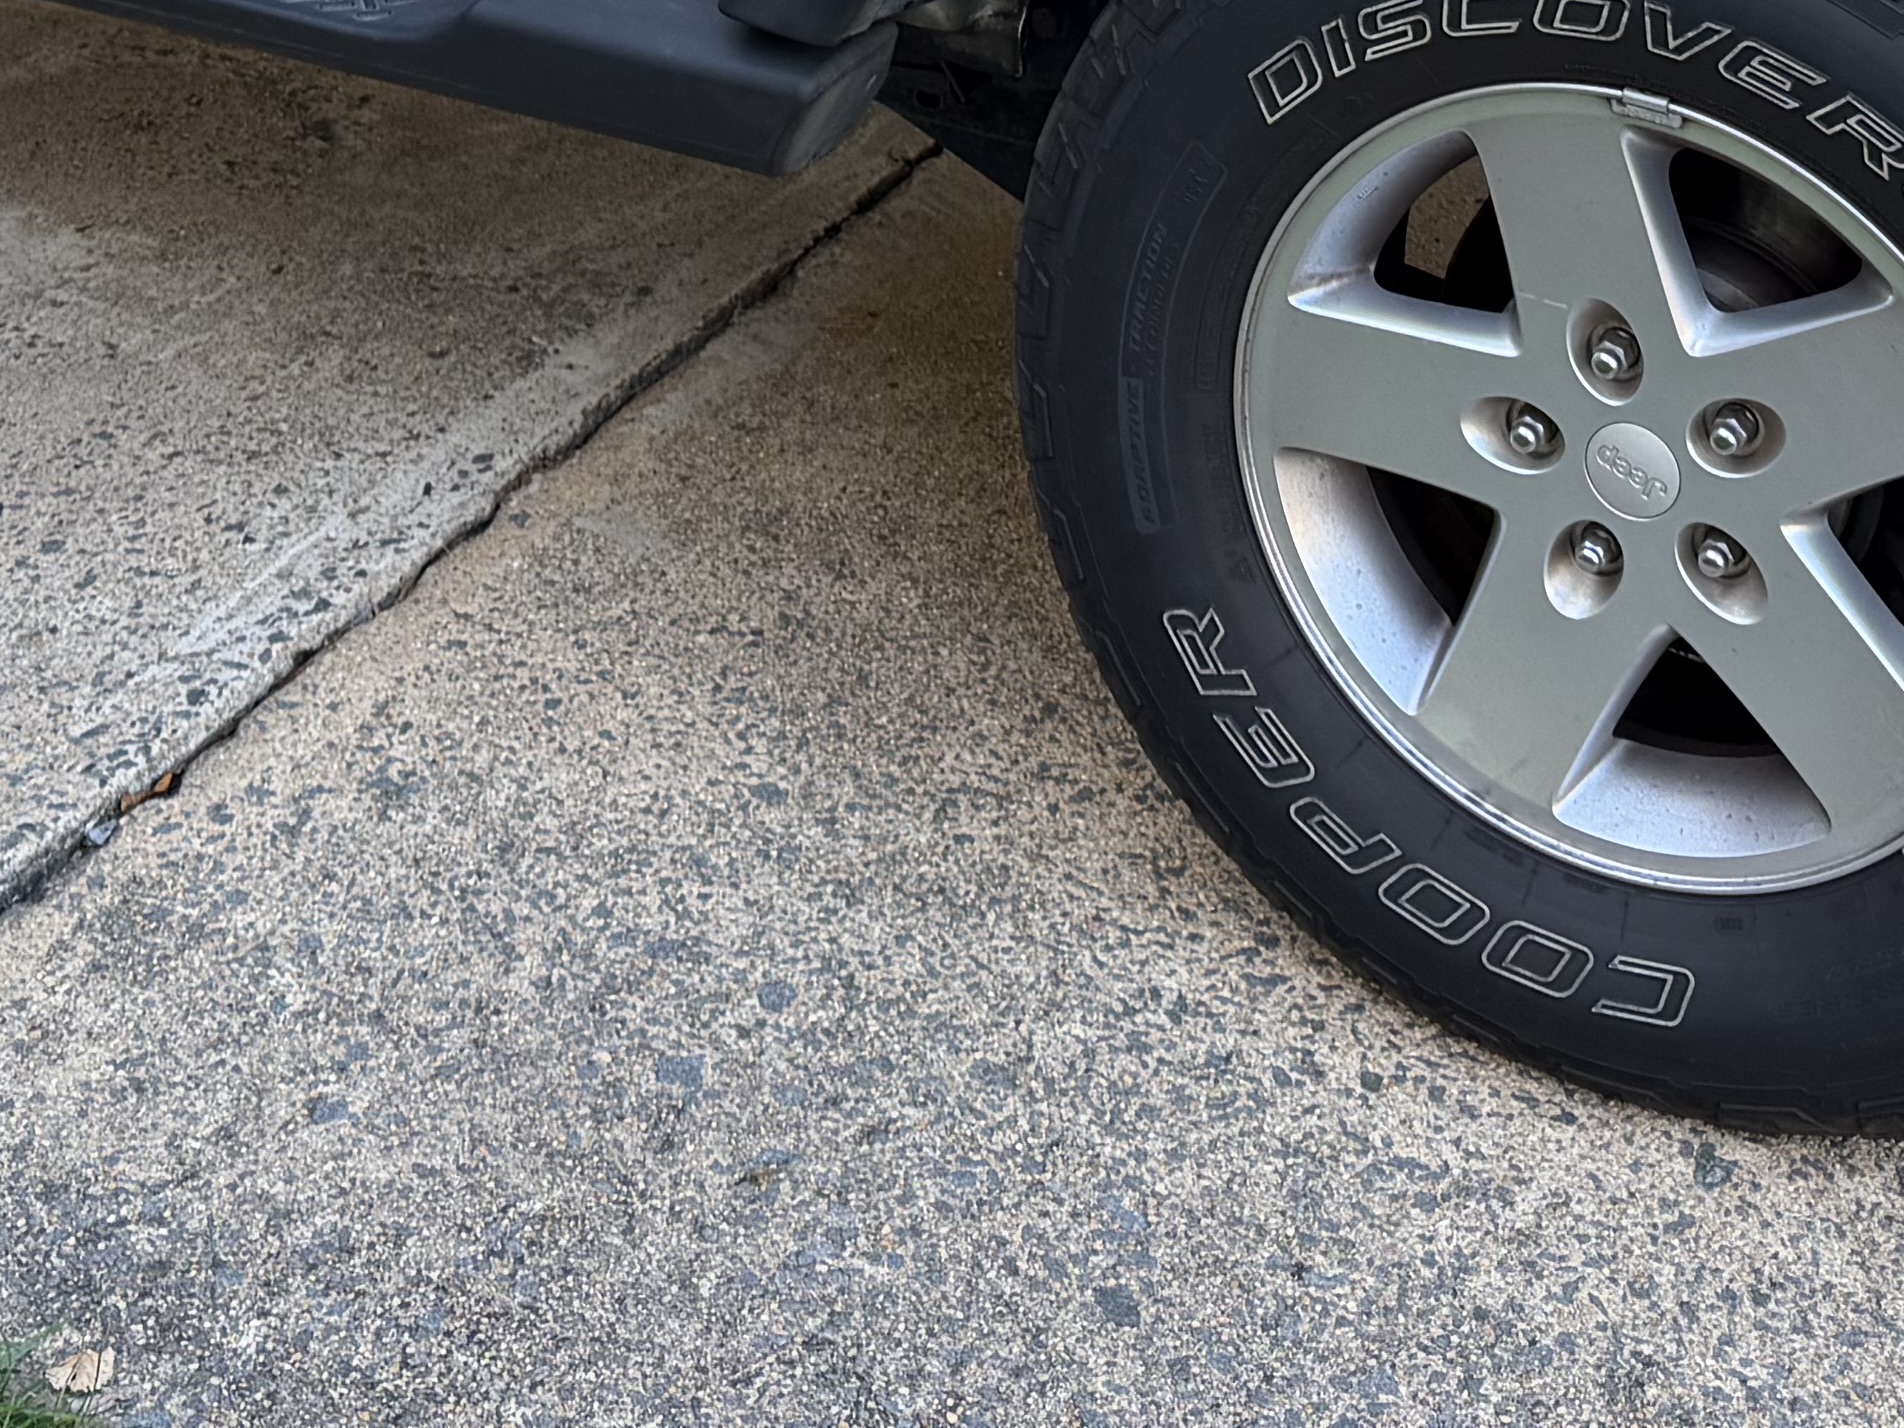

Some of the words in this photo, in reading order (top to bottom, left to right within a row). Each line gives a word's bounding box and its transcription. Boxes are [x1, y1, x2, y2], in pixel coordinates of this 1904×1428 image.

[1129, 223, 1169, 353] TRACTION
[1596, 444, 1668, 501] Jeep
[1163, 607, 1695, 1028] COOPER
